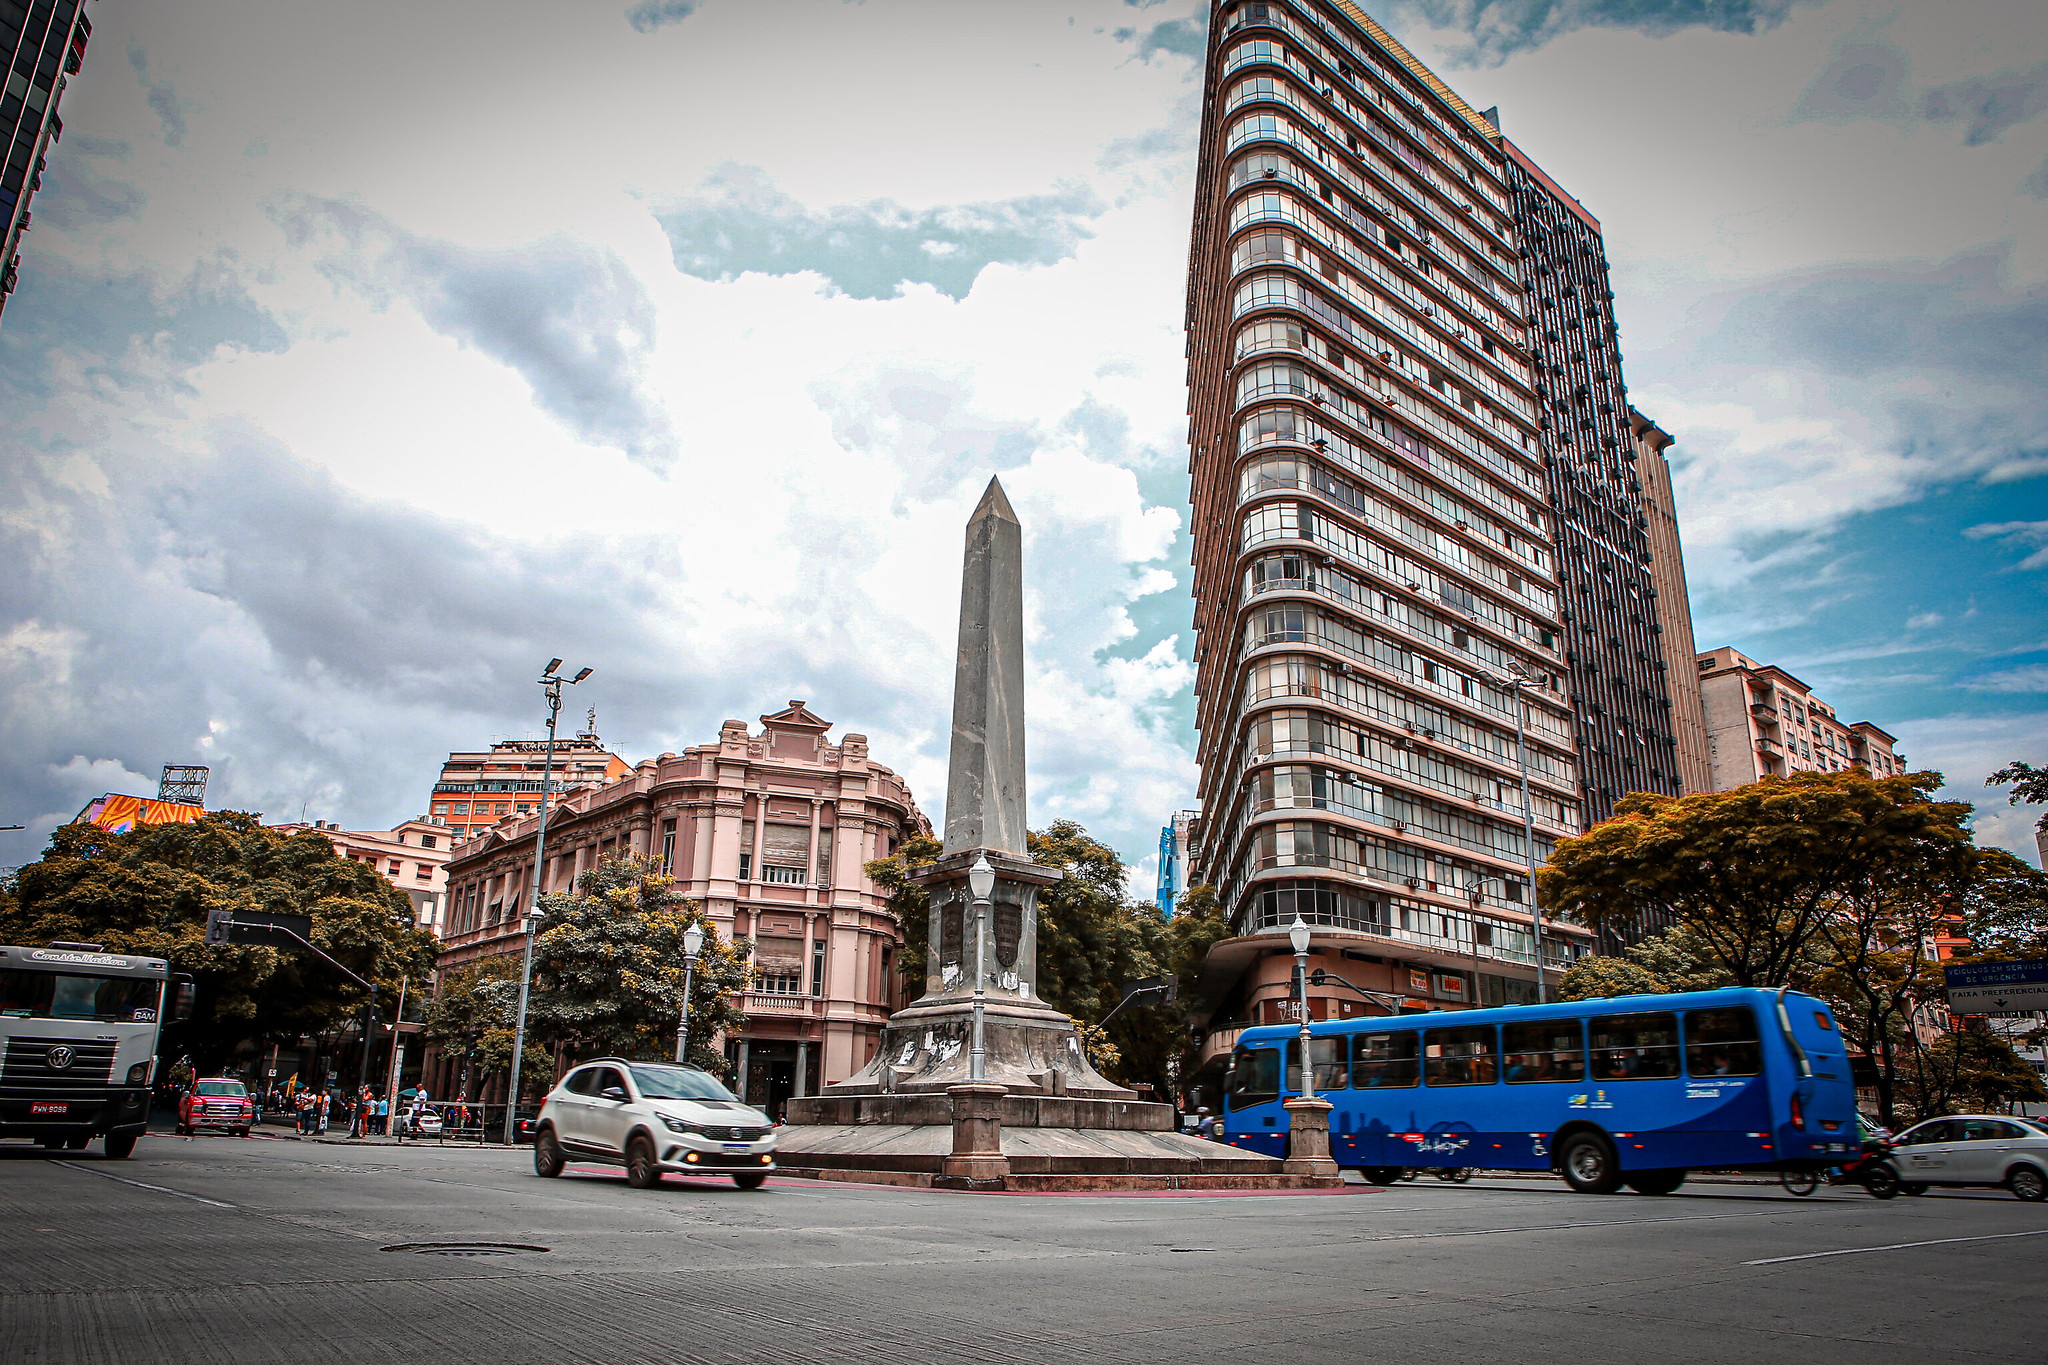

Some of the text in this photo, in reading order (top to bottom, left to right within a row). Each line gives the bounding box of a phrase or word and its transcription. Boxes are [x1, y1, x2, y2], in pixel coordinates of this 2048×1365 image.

[32, 950, 127, 966] Constellation
[1948, 966, 1988, 976] VEÍCULOS
[1982, 987, 2048, 997] PREFERENCIAL
[134, 1011, 156, 1021] GAM
